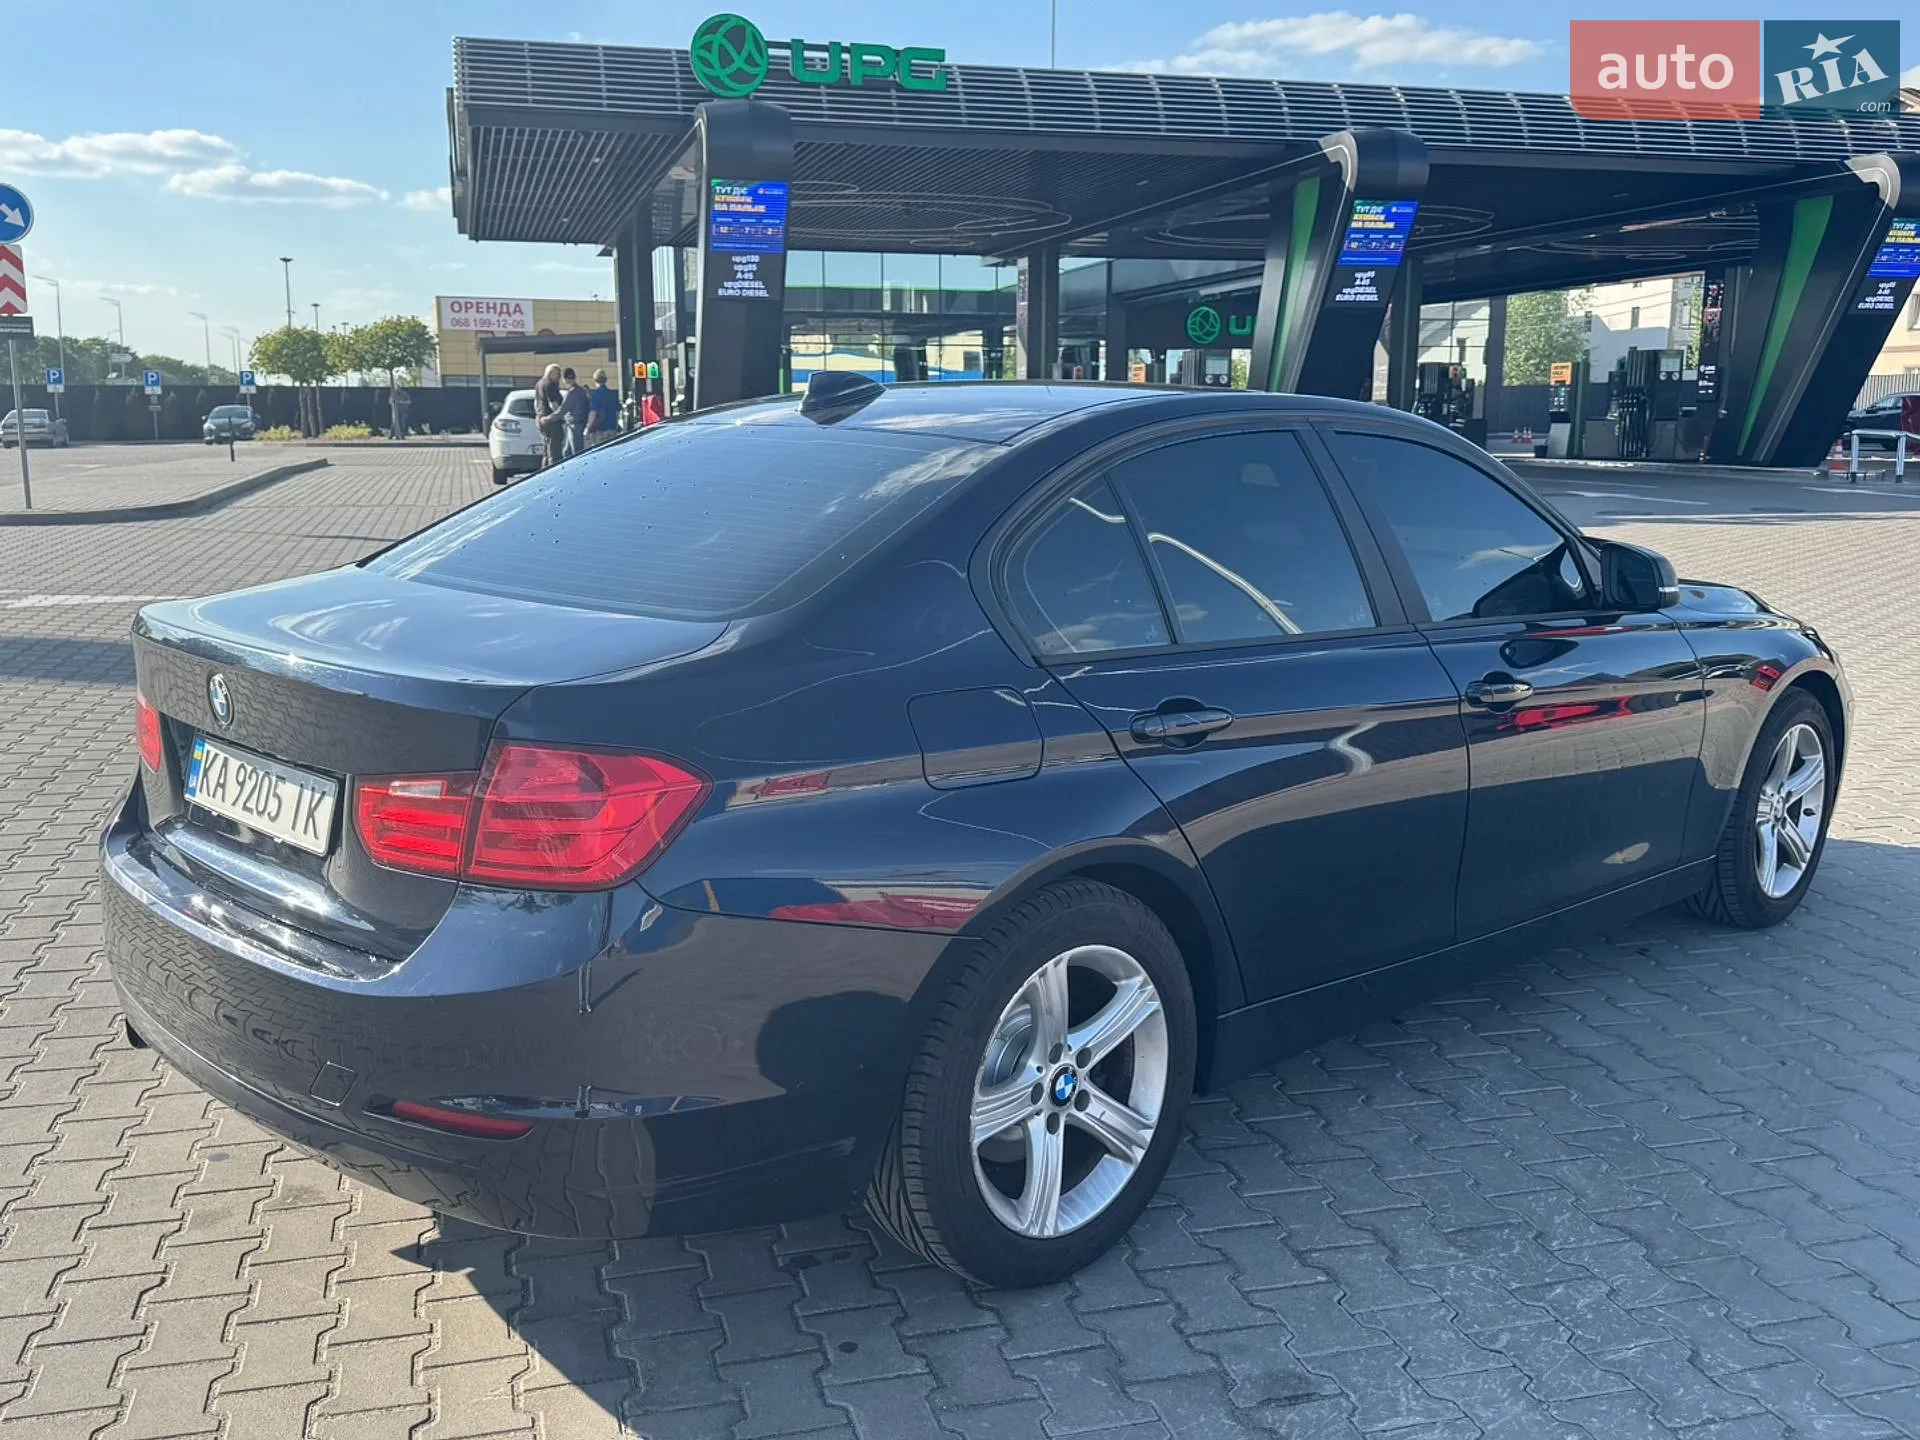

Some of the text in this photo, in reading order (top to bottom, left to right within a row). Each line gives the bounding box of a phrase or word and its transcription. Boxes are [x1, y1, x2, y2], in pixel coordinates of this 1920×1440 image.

[789, 38, 947, 91] UPG
[718, 288, 770, 297] EURO DIESEL
[450, 300, 524, 317] ОРЕНДА
[451, 317, 525, 329] 068 199-12-09
[231, 762, 287, 823] 9205
[291, 782, 327, 840] IK
